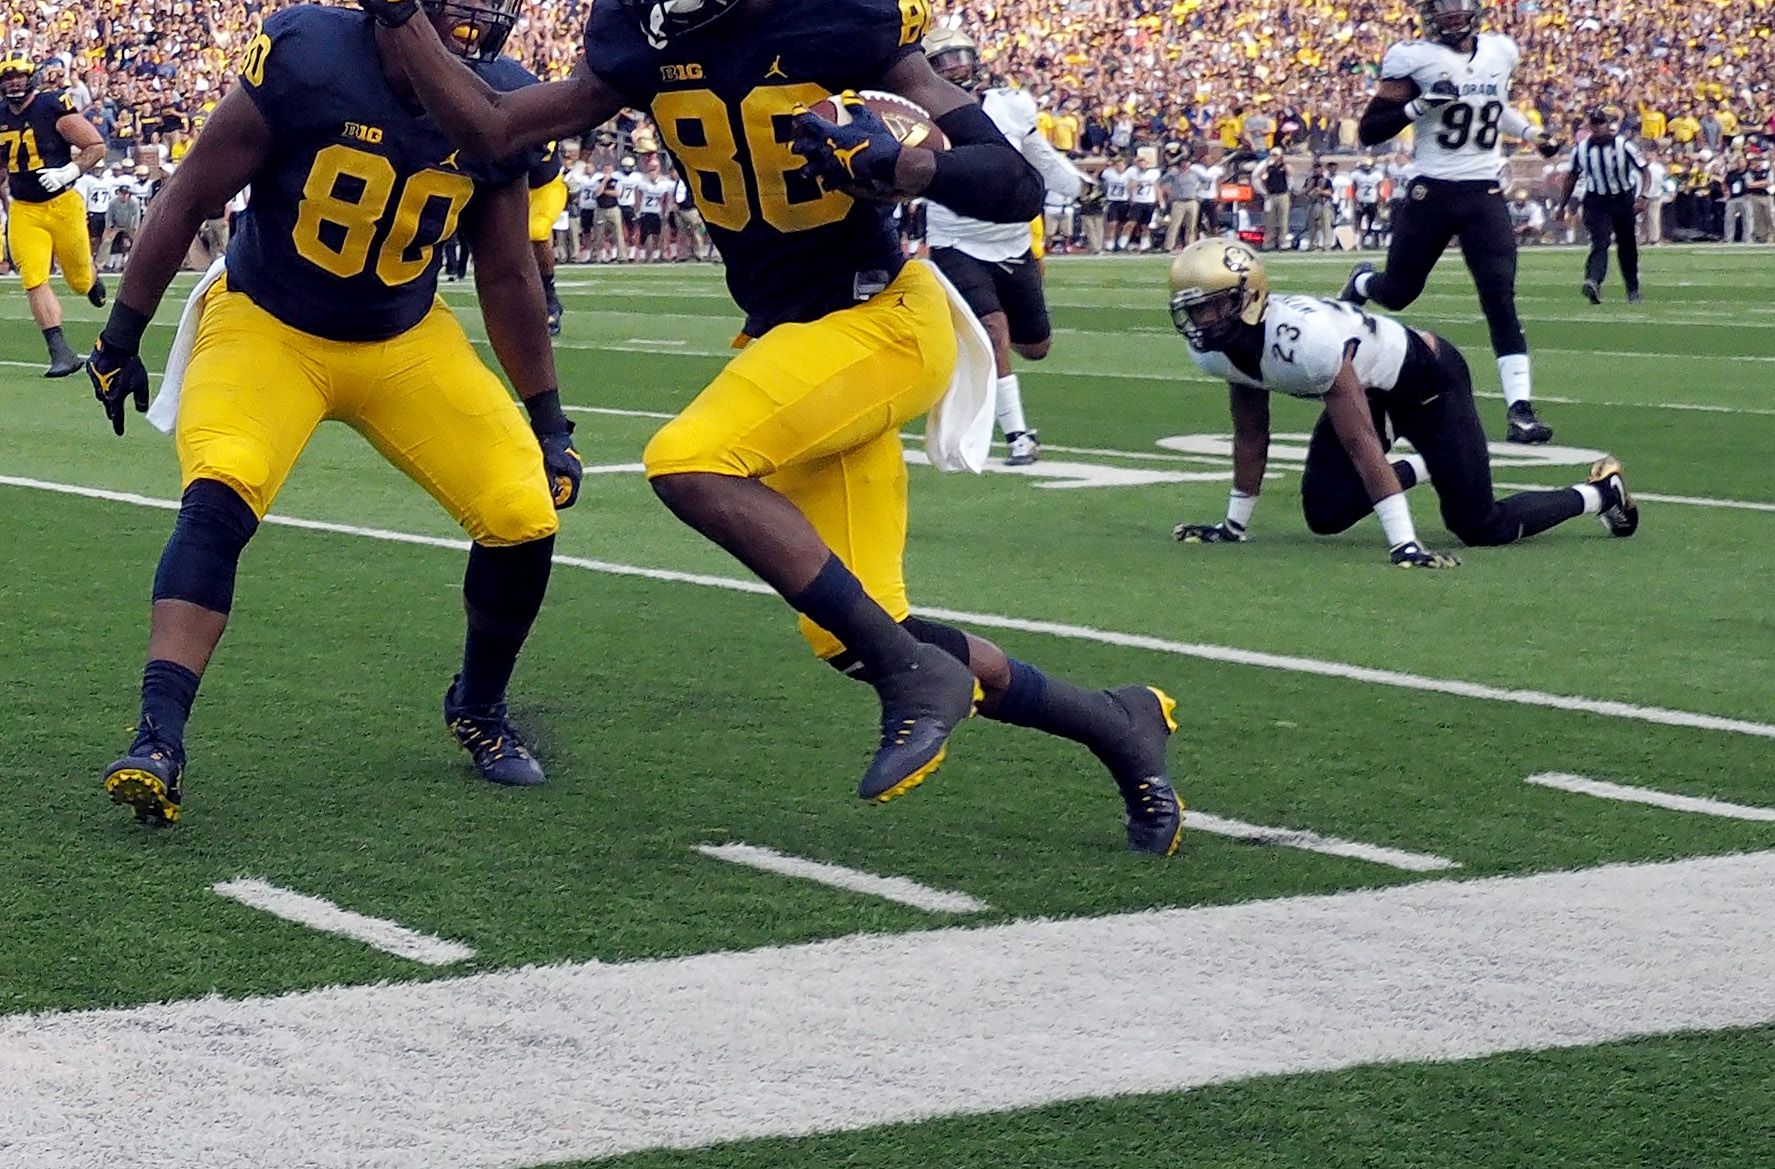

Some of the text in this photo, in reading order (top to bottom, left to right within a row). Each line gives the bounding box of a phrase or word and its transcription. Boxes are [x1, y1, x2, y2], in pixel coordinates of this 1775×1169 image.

[1436, 100, 1503, 150] 98
[91, 191, 110, 204] 47
[291, 143, 475, 287] 80
[1272, 323, 1302, 364] 23
